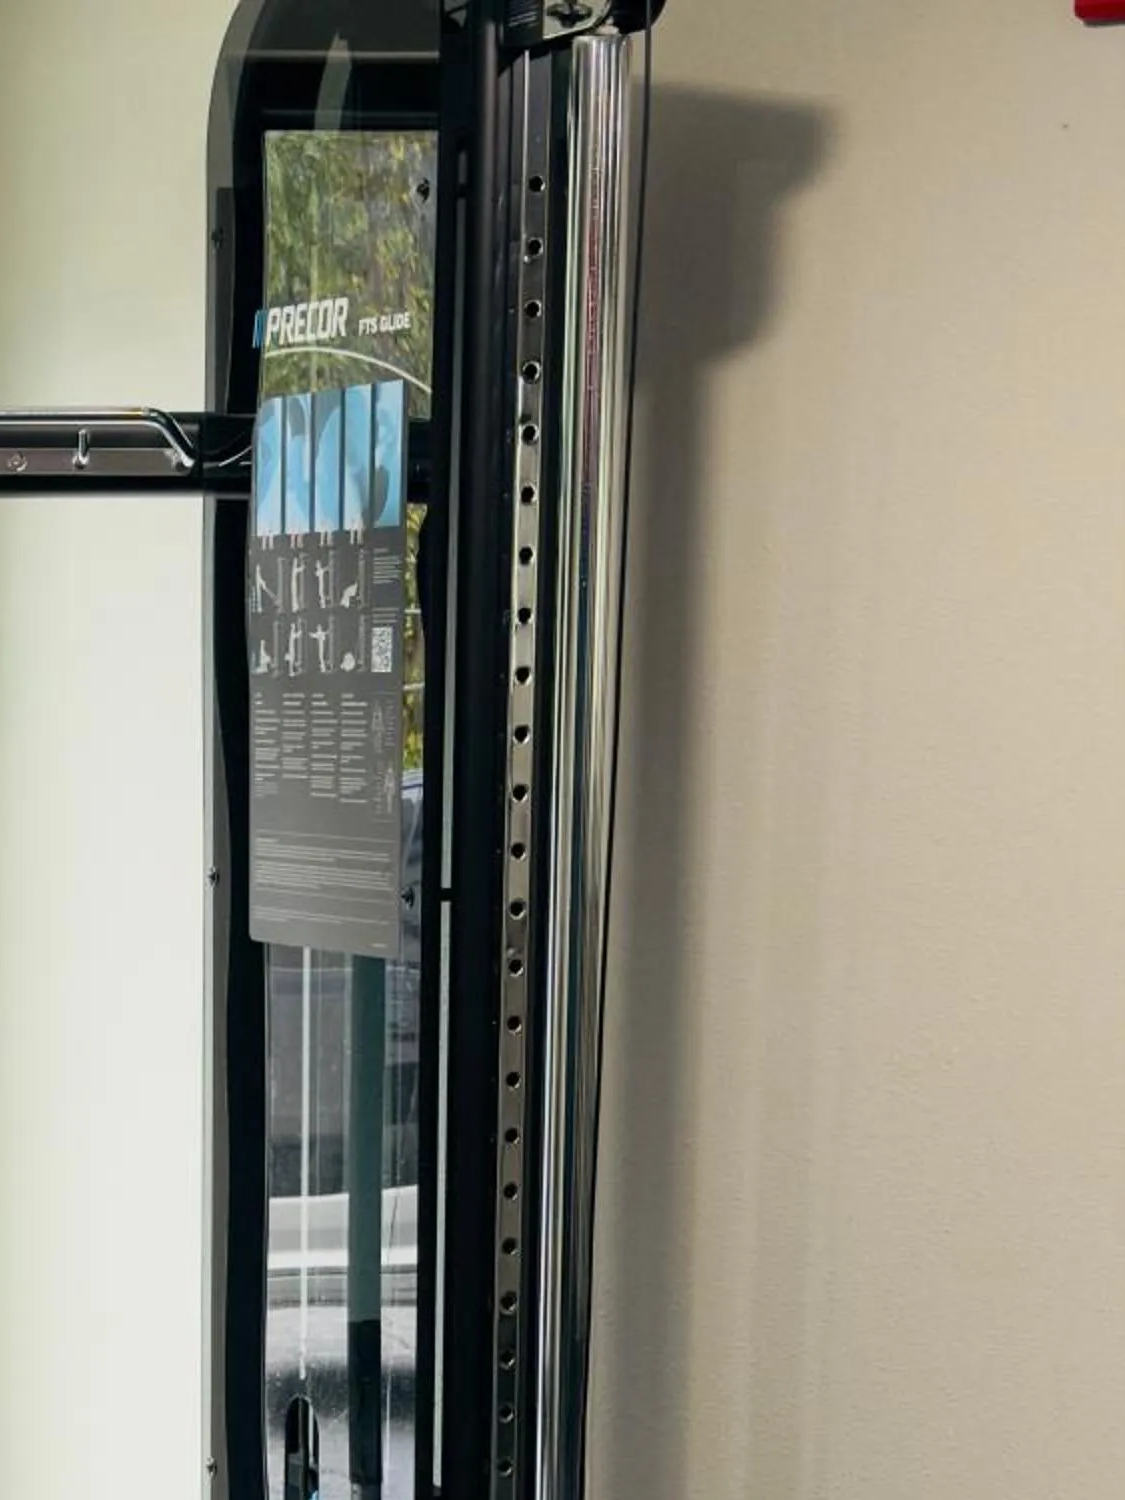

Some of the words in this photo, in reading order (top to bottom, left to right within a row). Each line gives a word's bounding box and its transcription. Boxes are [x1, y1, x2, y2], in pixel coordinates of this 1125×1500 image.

[266, 298, 348, 348] PRECOR
[358, 317, 377, 336] FTS
[378, 312, 411, 334] GLIDE
